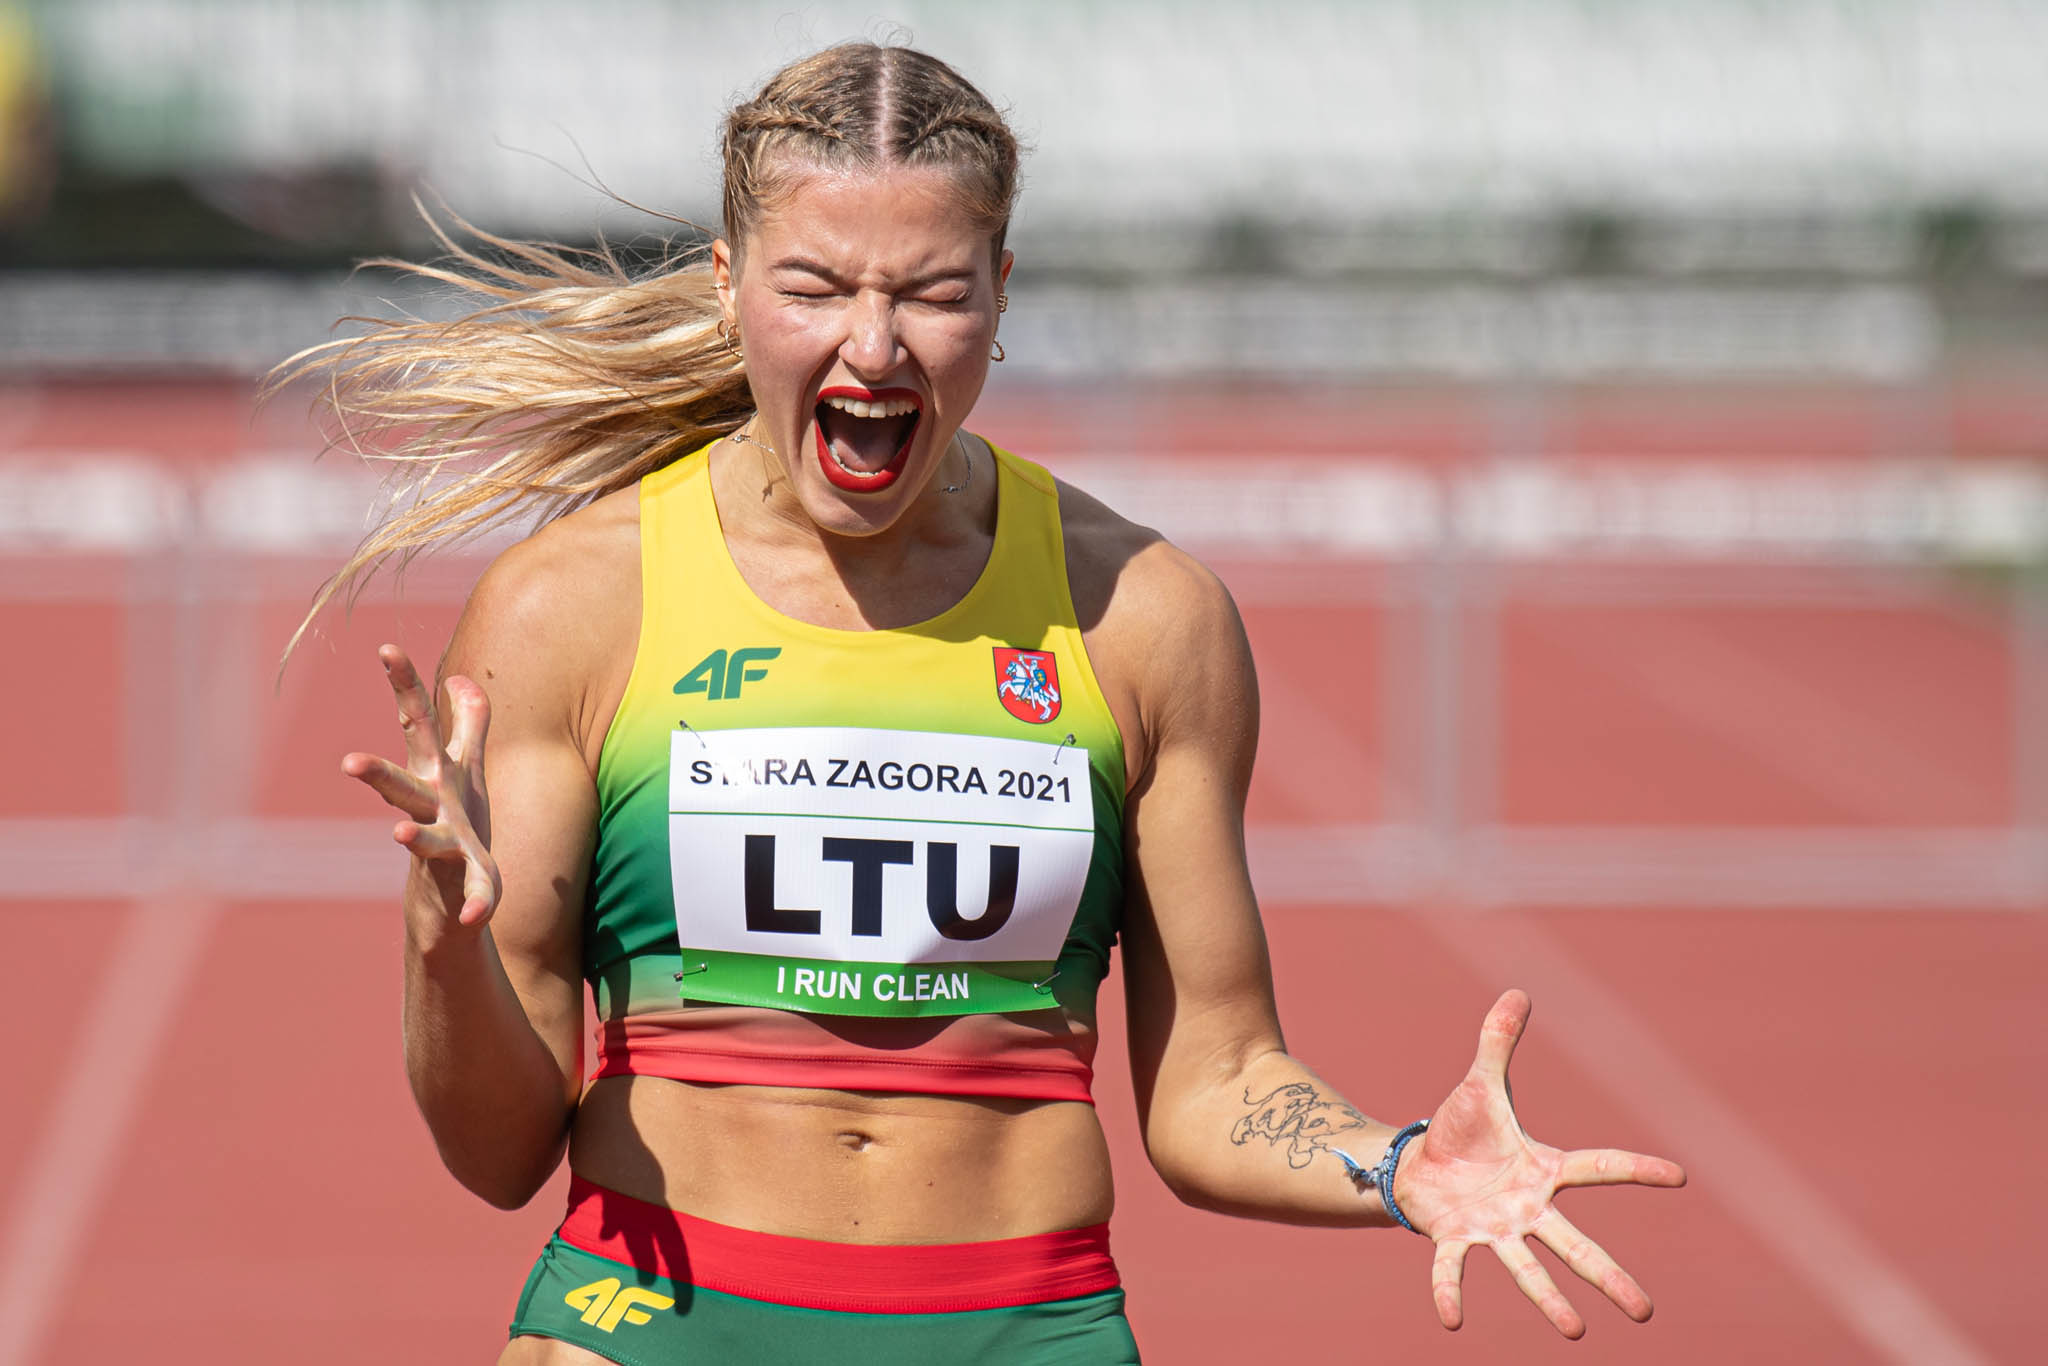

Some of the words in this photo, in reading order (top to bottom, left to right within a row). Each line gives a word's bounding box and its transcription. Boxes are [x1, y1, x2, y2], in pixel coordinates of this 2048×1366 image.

[673, 647, 782, 700] 4F
[690, 758, 817, 786] SRA
[826, 759, 988, 795] ZAGORA
[998, 769, 1071, 803] 2021
[744, 834, 1020, 941] LTU
[777, 966, 786, 994] I
[794, 967, 861, 1000] RUN
[873, 972, 970, 1000] CLEAN
[564, 1277, 676, 1334] 4F
